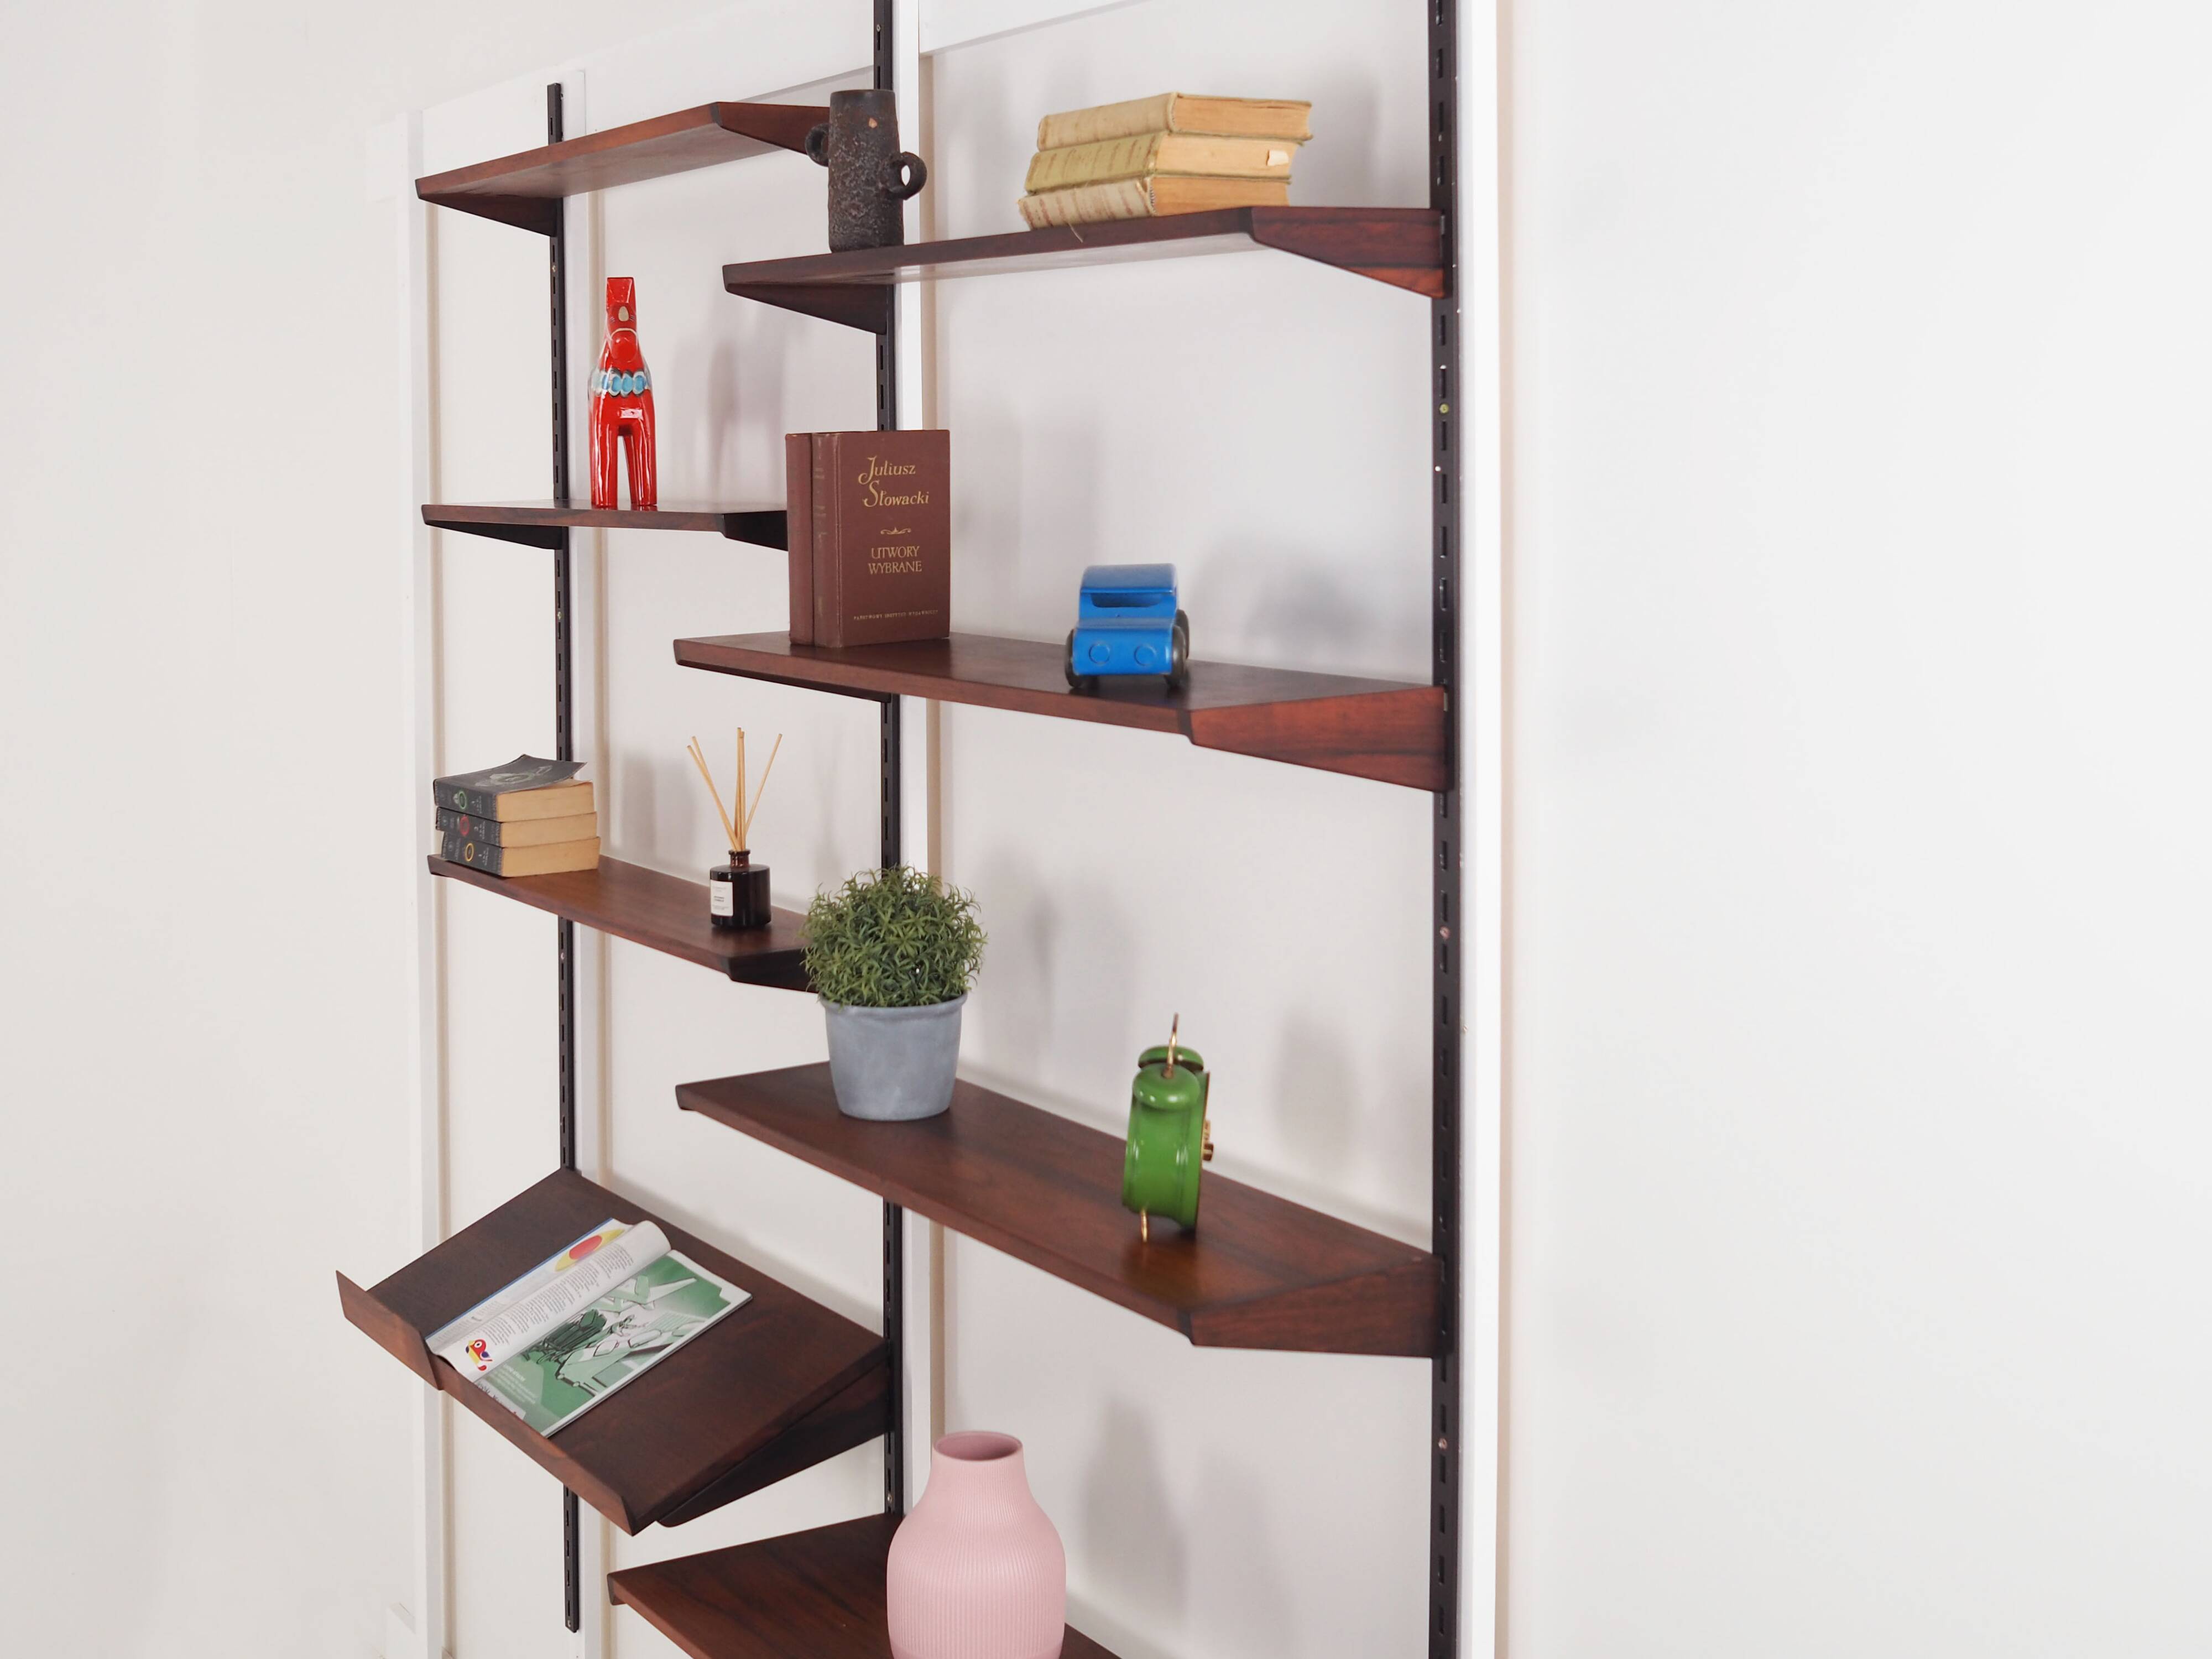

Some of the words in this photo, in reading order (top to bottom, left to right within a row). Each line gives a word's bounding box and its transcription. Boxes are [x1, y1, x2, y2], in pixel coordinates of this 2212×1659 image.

[858, 455, 916, 485] Juliusz
[862, 479, 929, 508] Słowacki
[871, 545, 920, 559] UTWORY
[868, 560, 922, 575] WYBRANE
